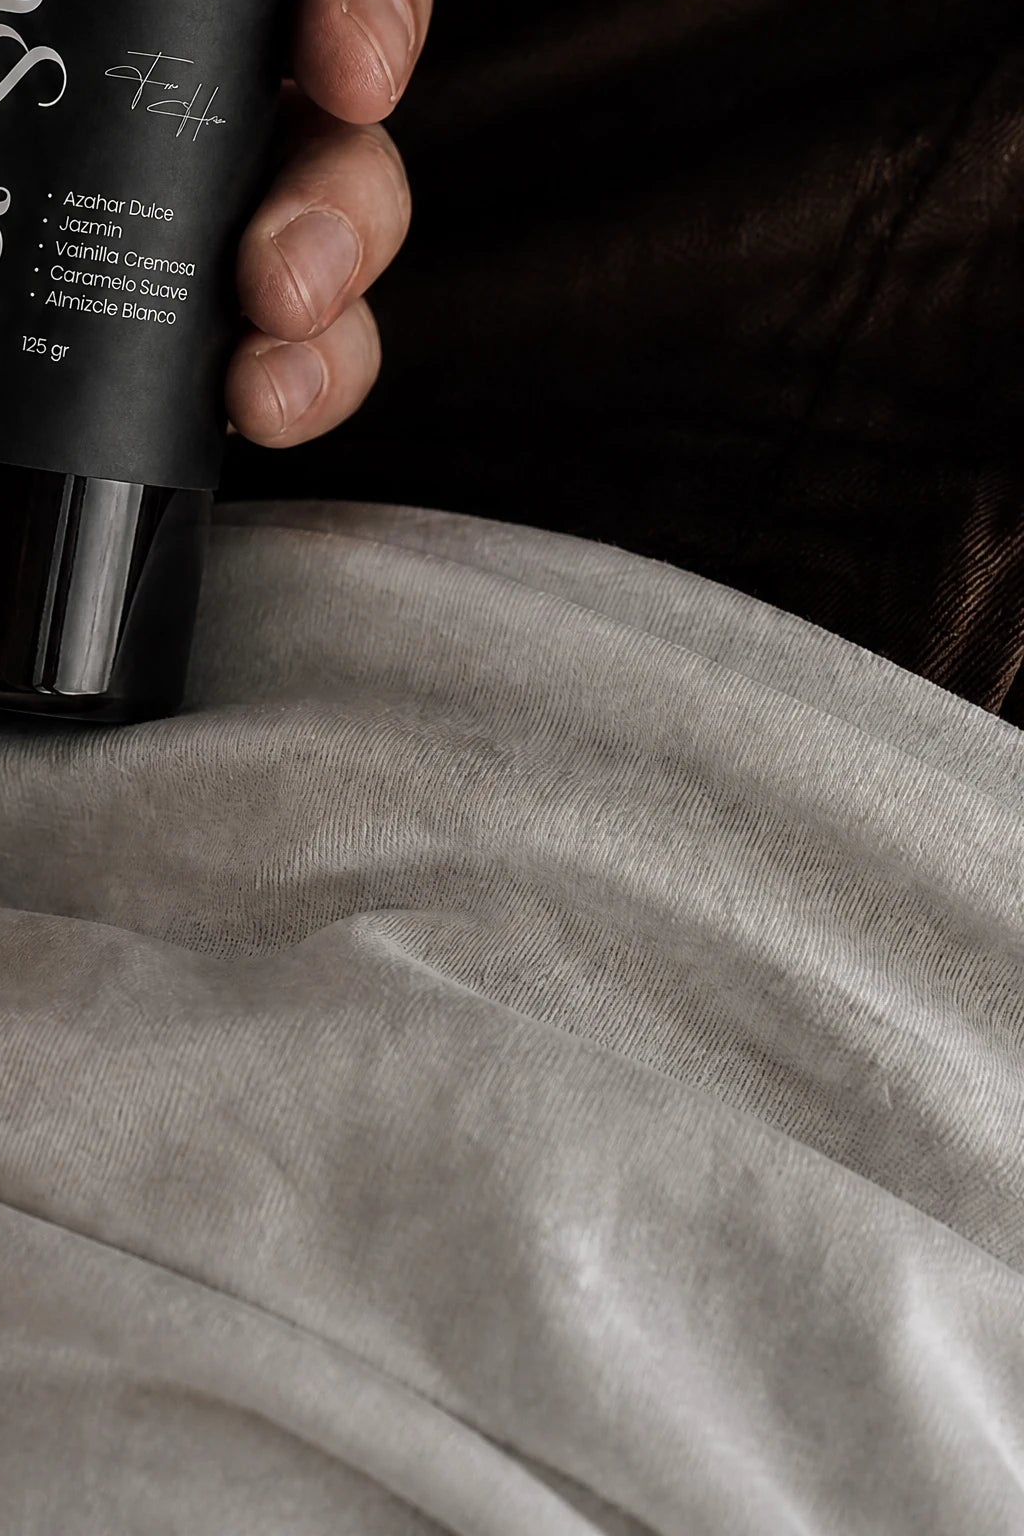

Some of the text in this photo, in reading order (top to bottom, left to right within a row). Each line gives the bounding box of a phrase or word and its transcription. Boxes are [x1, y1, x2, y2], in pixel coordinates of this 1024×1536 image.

[63, 191, 174, 221] Azahar Dulce
[59, 216, 123, 238] Jazmin
[55, 241, 195, 276] Vainilla Cremosa
[50, 265, 188, 301] Caramelo Suave
[45, 291, 176, 325] Almizcle Blanco
[21, 335, 69, 362] 125 gr
